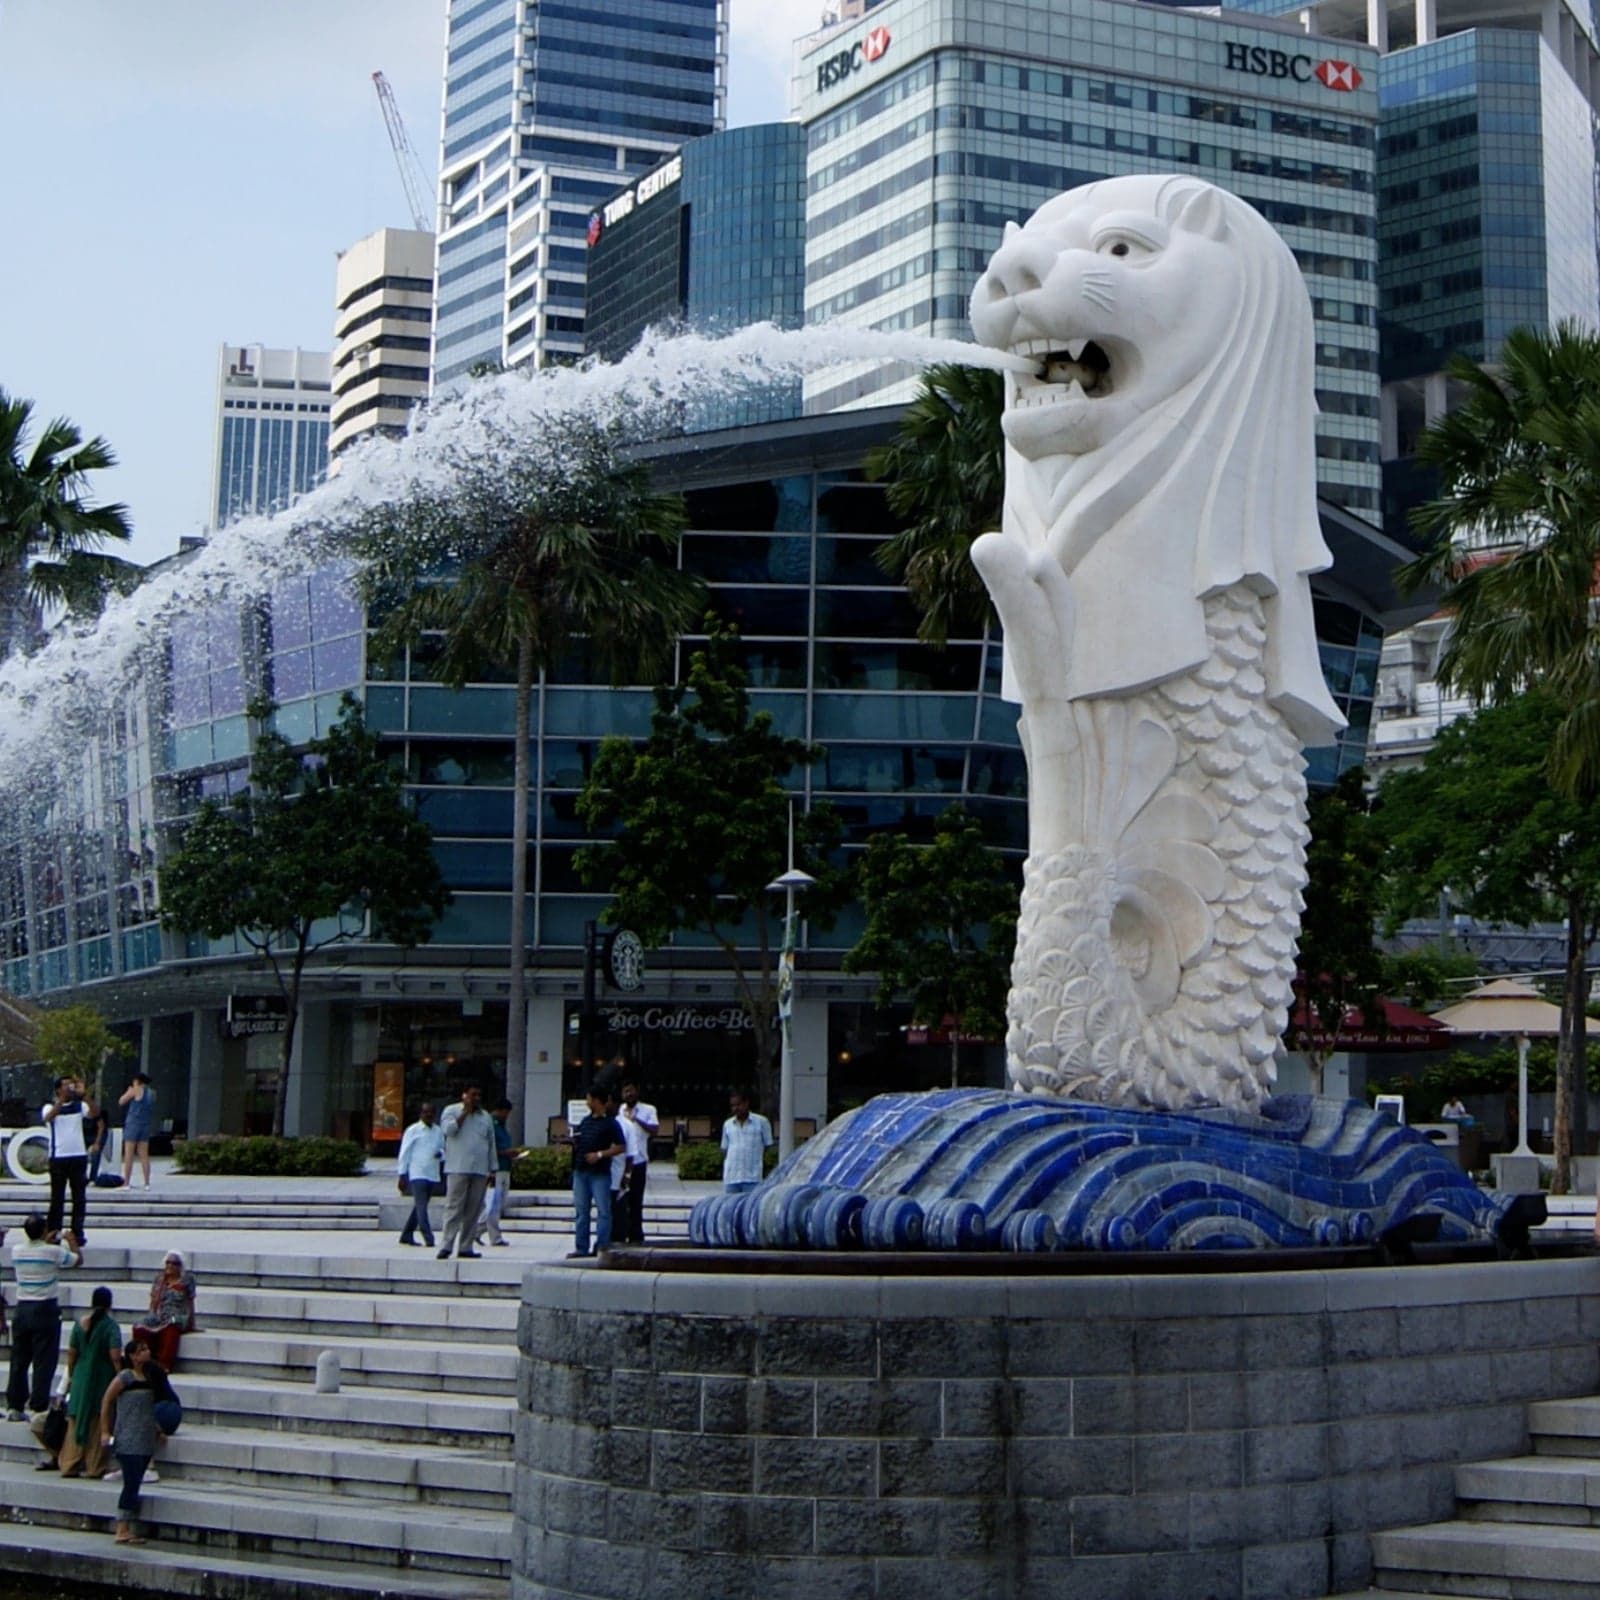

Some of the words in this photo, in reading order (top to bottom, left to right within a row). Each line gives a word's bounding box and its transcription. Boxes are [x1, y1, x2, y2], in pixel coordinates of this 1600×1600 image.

[816, 42, 863, 93] HSBC
[1224, 40, 1312, 84] HSBC
[637, 155, 682, 205] CENTRE
[598, 1006, 640, 1032] The
[643, 1006, 718, 1030] Coffee
[720, 1006, 783, 1031] Ben
